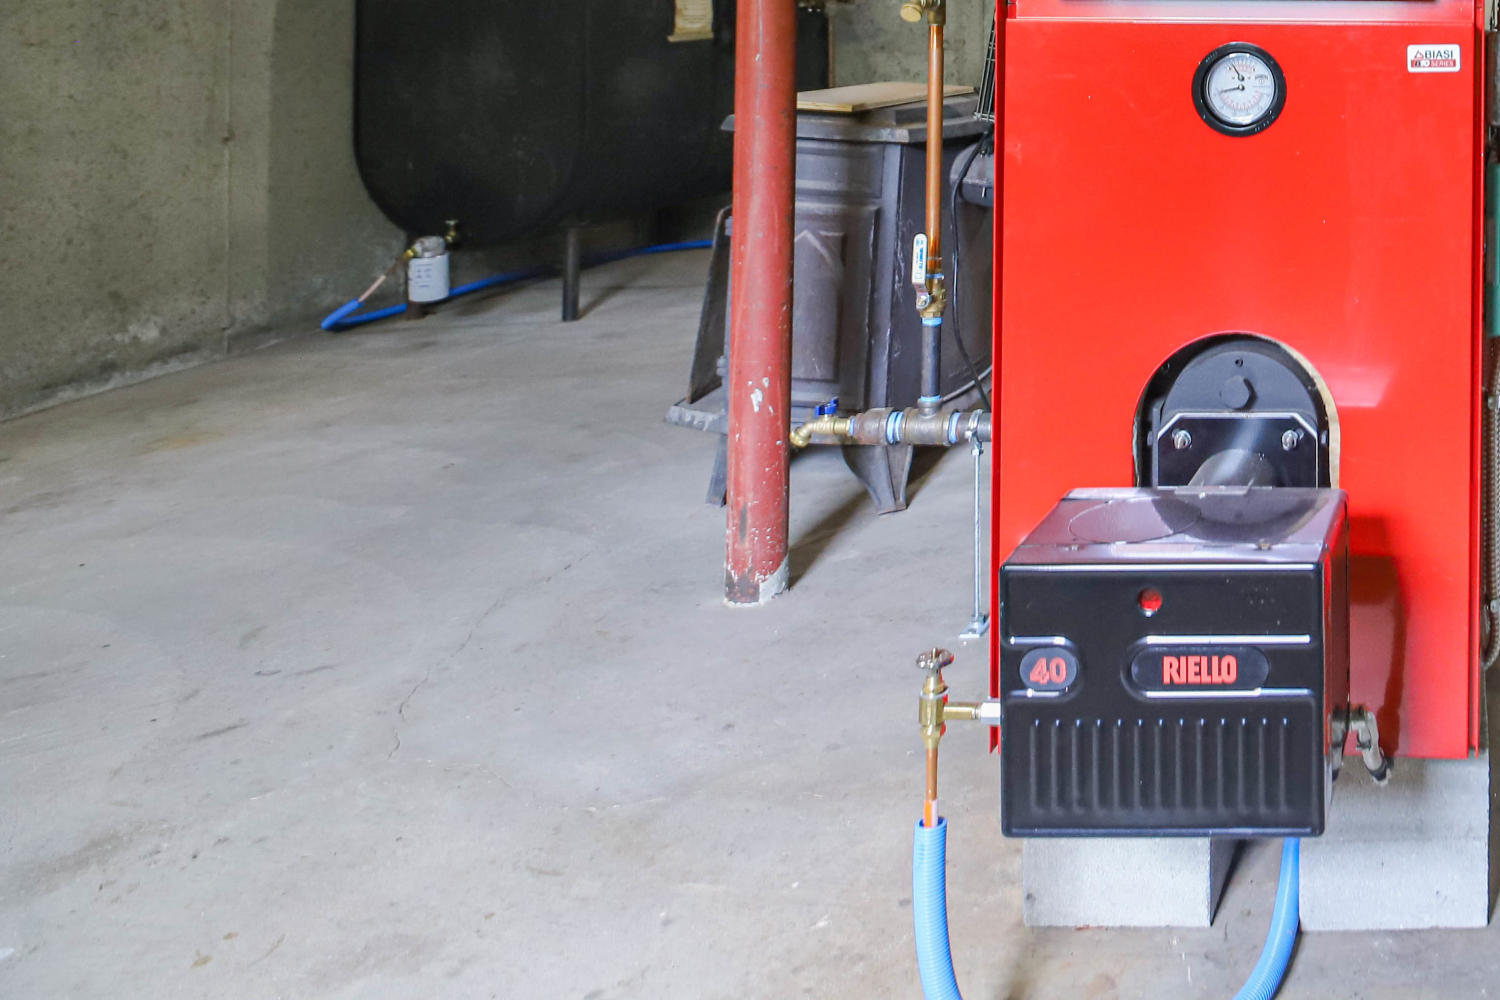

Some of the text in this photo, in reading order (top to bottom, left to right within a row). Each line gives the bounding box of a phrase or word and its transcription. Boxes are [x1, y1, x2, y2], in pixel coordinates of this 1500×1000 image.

[1424, 49, 1453, 59] BIASI
[1030, 658, 1067, 684] 40
[1163, 656, 1237, 684] RIELLO
